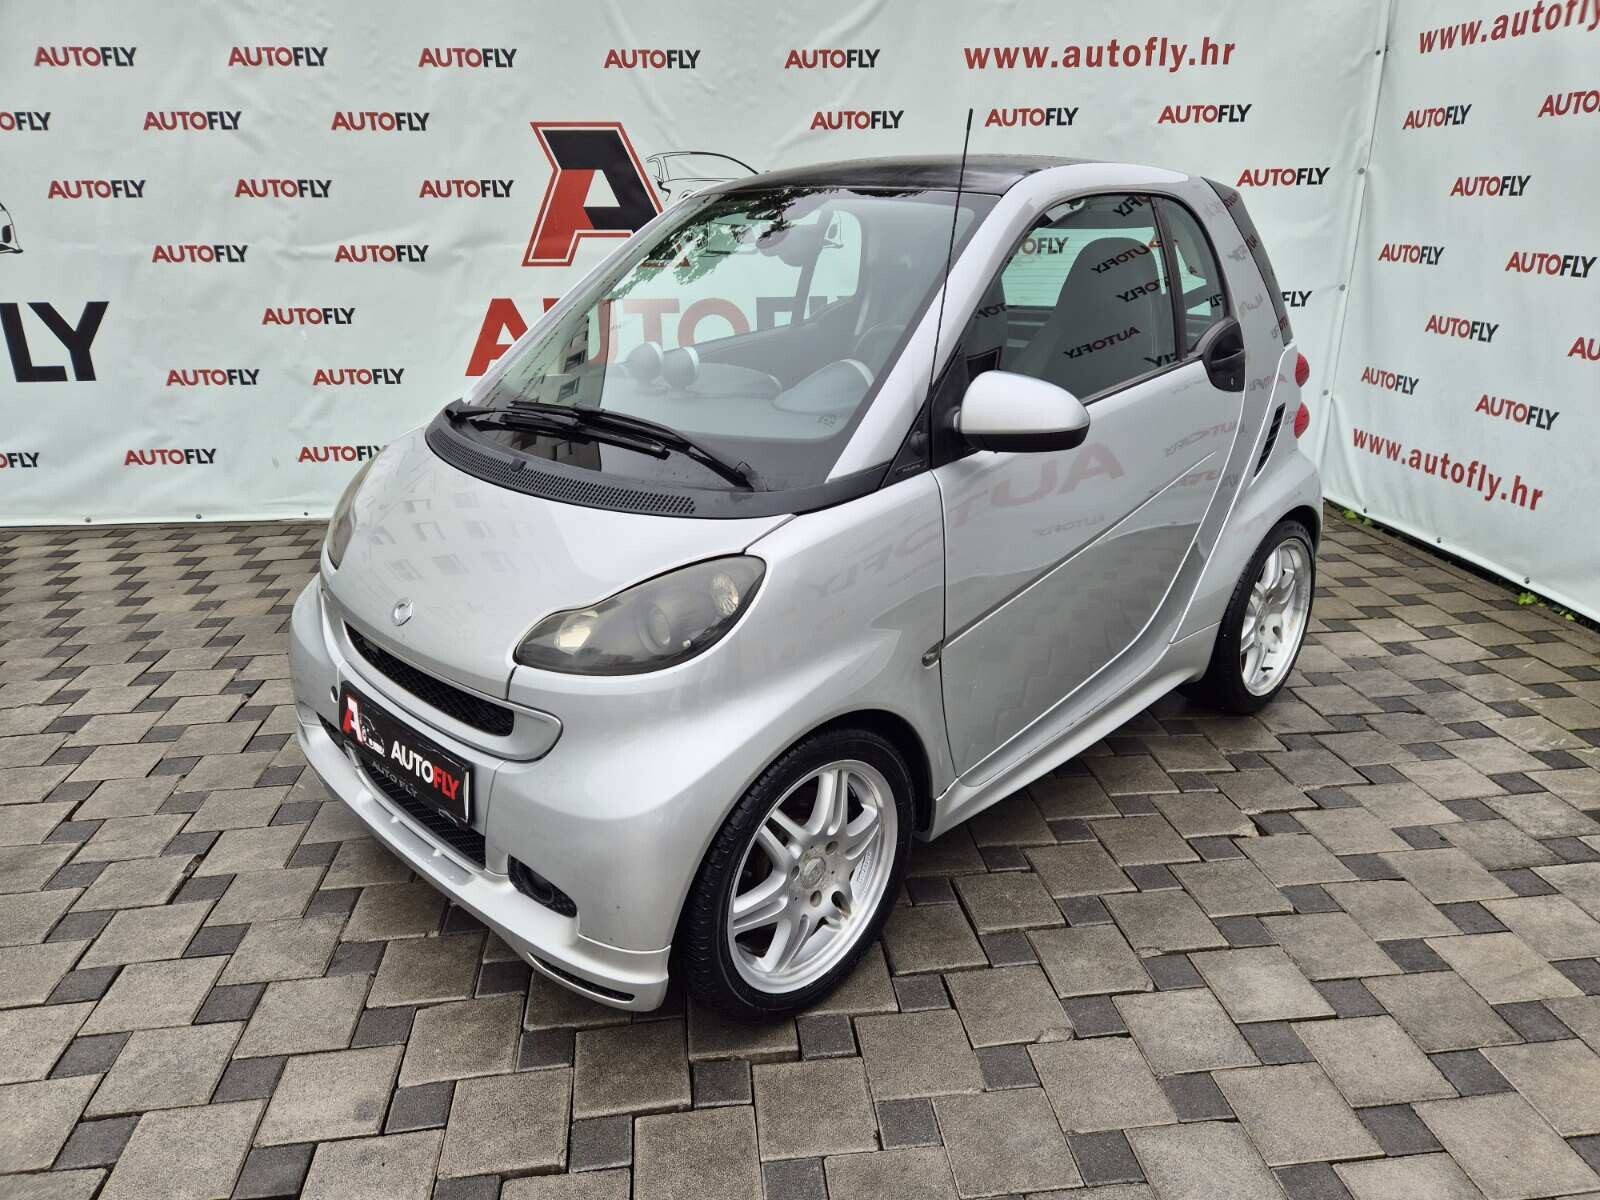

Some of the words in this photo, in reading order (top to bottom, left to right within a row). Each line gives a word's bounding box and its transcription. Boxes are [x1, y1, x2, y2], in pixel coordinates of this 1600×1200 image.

[34, 47, 136, 66] AUTOFLY
[229, 47, 328, 66] AUTOFLY
[418, 48, 517, 68] AUTOFLY
[604, 49, 700, 69] AUTOFLY
[785, 49, 880, 69] AUTOFLY
[964, 37, 1235, 72] www.autofly.hr
[1158, 104, 1252, 124] AUTOFLY
[1538, 90, 1600, 118] AUTO
[0, 112, 51, 131] OFLY
[144, 111, 242, 130] AUTOFLY
[331, 112, 430, 131] AUTOFLY
[810, 110, 904, 130] AUTOFLY
[985, 107, 1079, 127] AUTOFLY
[1402, 104, 1472, 130] AUTOFLY
[1236, 167, 1330, 187] AUTOFLY
[1450, 175, 1531, 196] AUTOFLY
[48, 180, 146, 199] AUTOFLY
[235, 179, 332, 198] AUTOFLY
[419, 180, 514, 198] AUTOFLY
[152, 245, 248, 263] AUTOFLY
[335, 245, 429, 262] AUTOFLY
[1378, 244, 1445, 265] AUTOFLY
[1505, 252, 1598, 278] AUTOFLY
[262, 308, 355, 325] AUTOFLY
[1425, 315, 1499, 343] AUTOFLY
[0, 301, 109, 382] LY
[166, 369, 259, 386] AUTOFLY
[313, 368, 404, 385] AUTOFLY
[1361, 367, 1419, 395] AUTOFLY
[1475, 395, 1559, 430] AUTOFLY
[124, 448, 216, 465] AUTOFLY
[1353, 428, 1544, 511] www.autofly.hr
[391, 740, 459, 800] AUTOFLY
